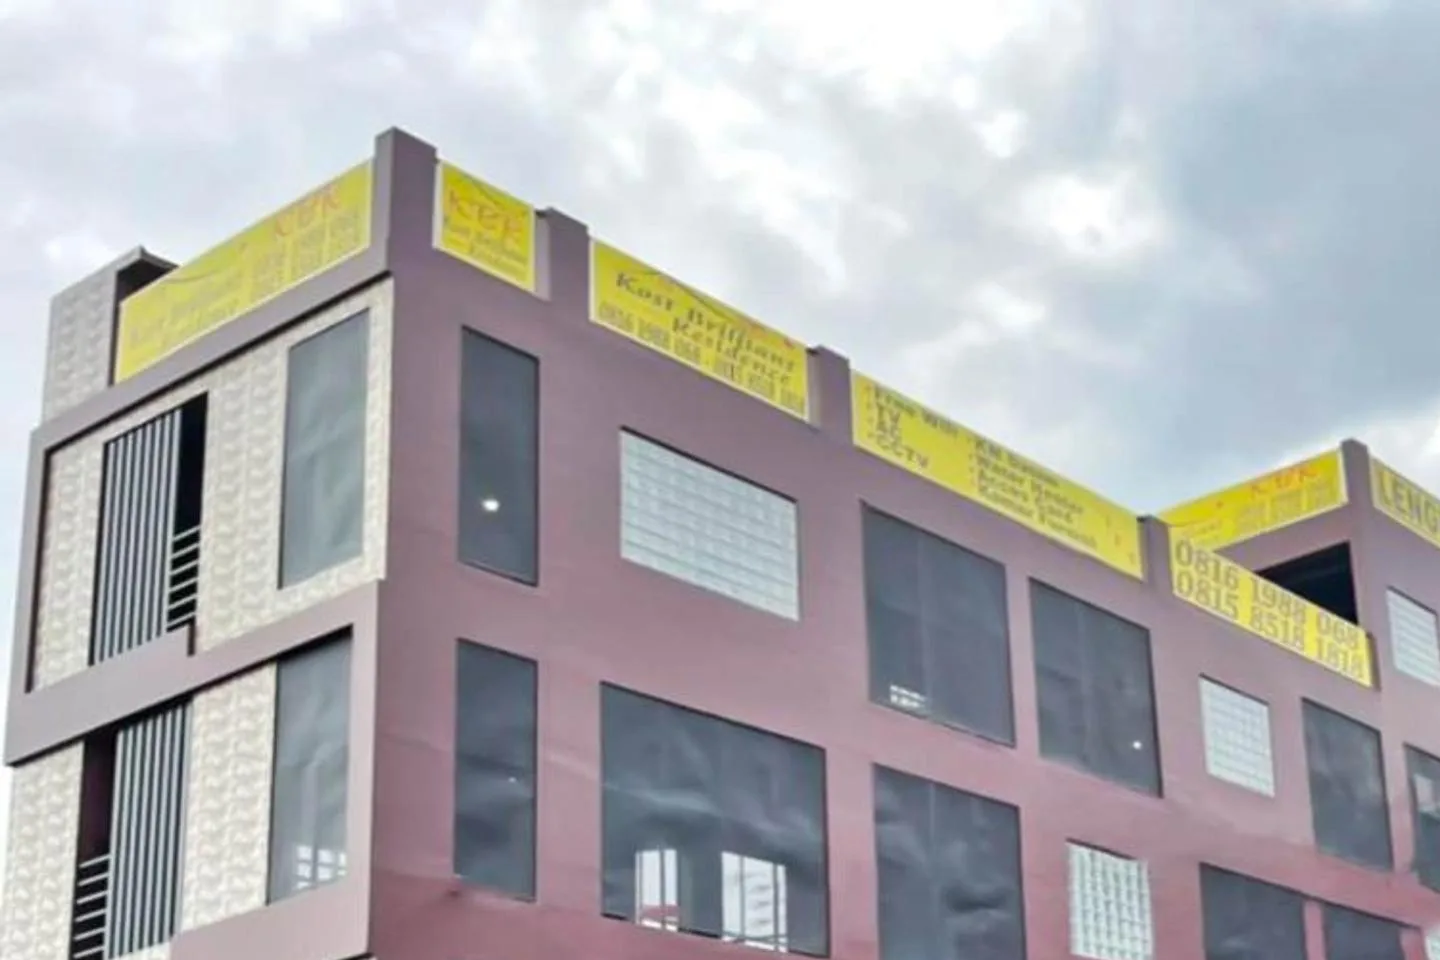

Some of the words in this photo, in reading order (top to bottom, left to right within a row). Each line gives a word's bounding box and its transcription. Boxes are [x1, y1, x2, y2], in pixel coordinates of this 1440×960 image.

[1175, 538, 1240, 590] 0816
[1250, 574, 1308, 624] 1988
[1317, 607, 1361, 648] 068
[1175, 569, 1240, 622] 0815
[1249, 604, 1306, 653] 8518
